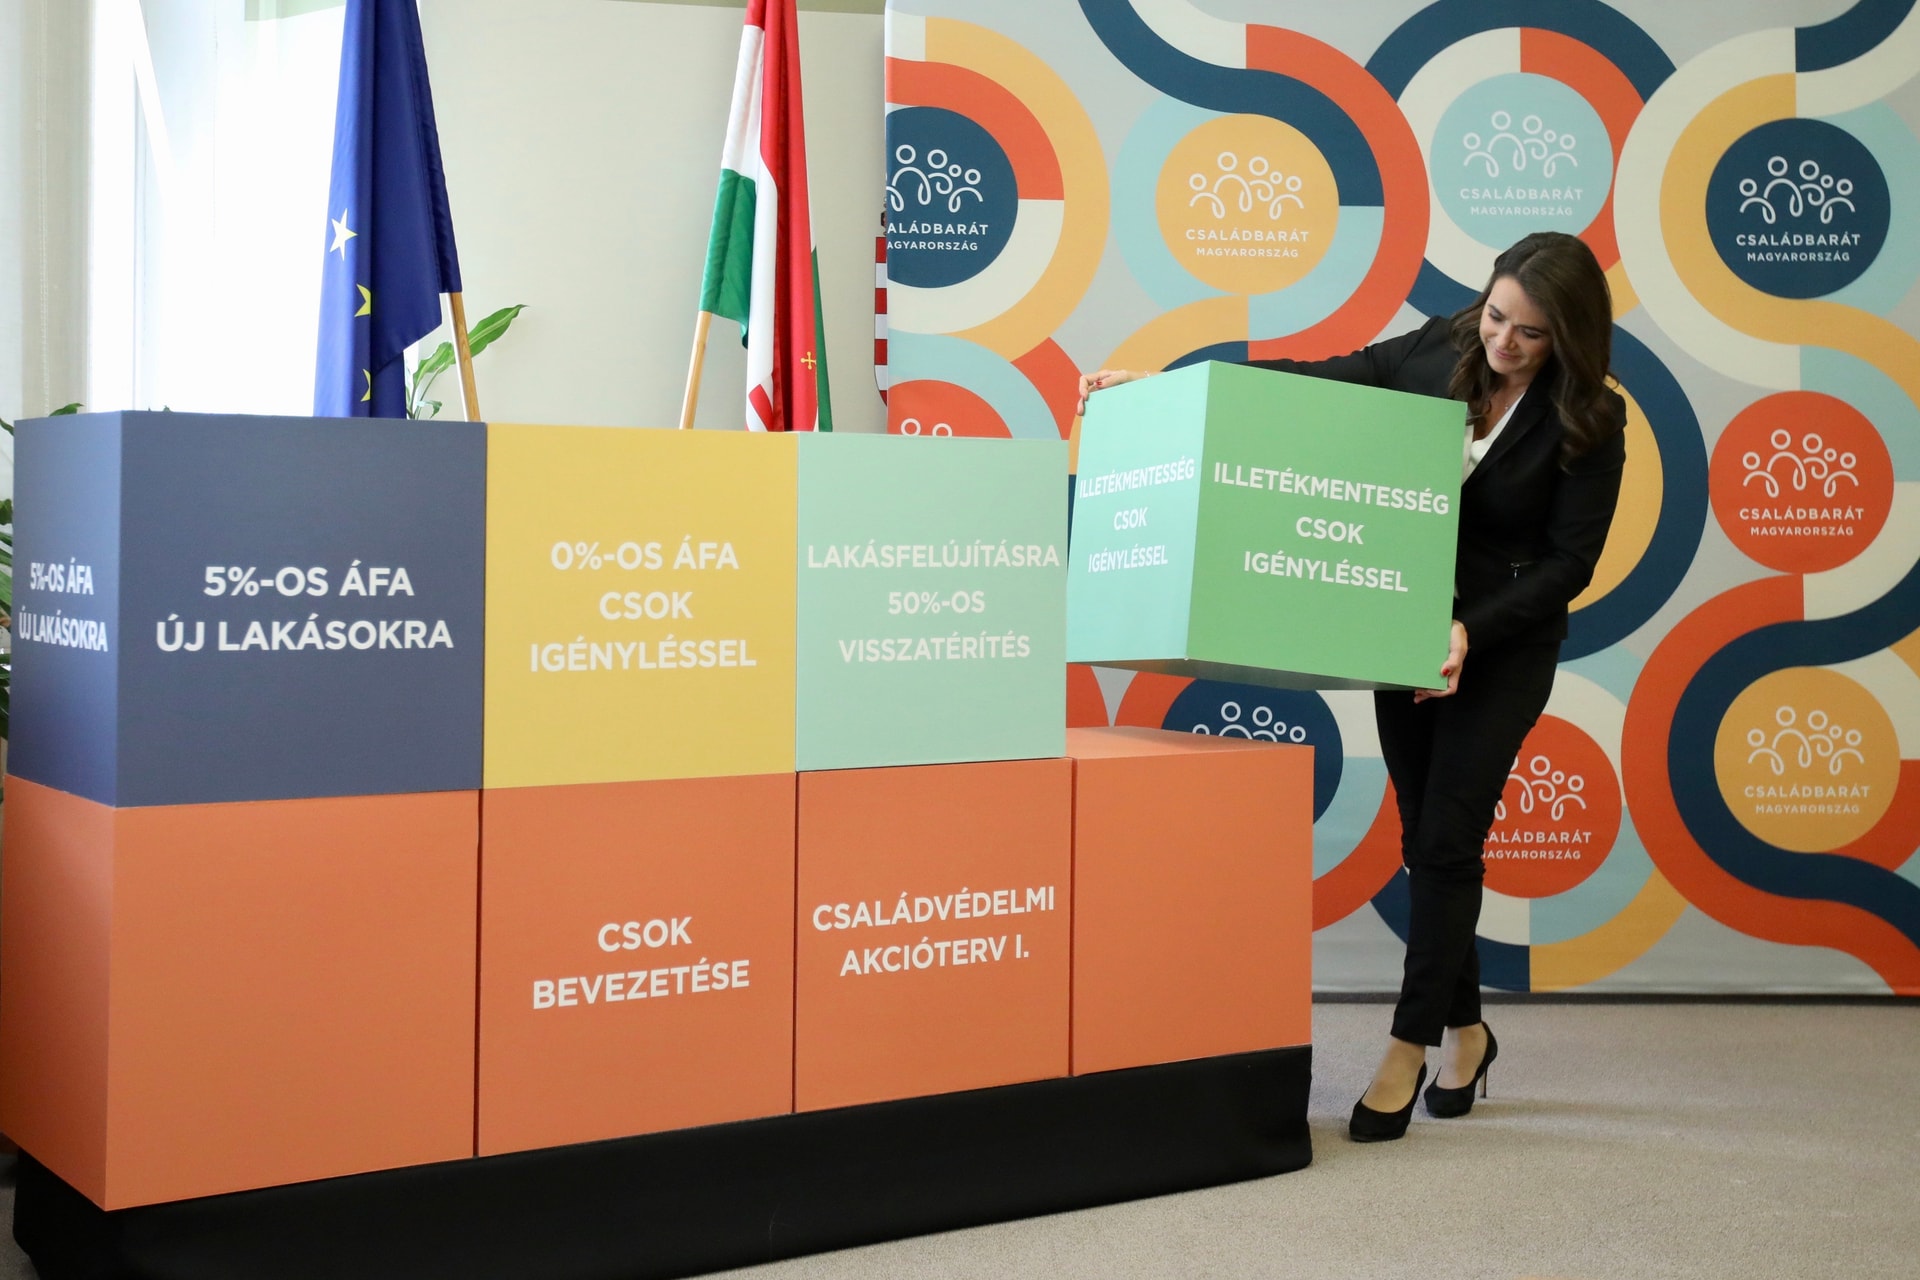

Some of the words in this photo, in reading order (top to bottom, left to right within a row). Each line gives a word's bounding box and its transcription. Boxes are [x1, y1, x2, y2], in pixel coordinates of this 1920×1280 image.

[1460, 186, 1582, 200] CSALÁDBARÁT
[1471, 205, 1572, 216] MAGYARORSZÁG
[887, 220, 988, 235] ALÁDBARÁT
[1186, 228, 1308, 241] CSALÁDBARÁT
[1736, 232, 1860, 246] CSALÁDBARÁT
[887, 239, 978, 251] AGYARORSZÁG
[1197, 247, 1298, 258] MAGYARORSZÁG
[1748, 250, 1849, 262] MAGYARORSZÁG
[1079, 455, 1195, 498] ILLETÉKMENTESSÉG
[1213, 462, 1449, 515] ILLETÉKMENTESSÉG
[1114, 507, 1147, 530] CSOK
[1739, 506, 1863, 520] CSALÁDBARÁT
[1296, 517, 1364, 544] CSOK
[1751, 525, 1853, 536] MAGYARORSZÁG
[551, 542, 663, 570] 0%-OS
[673, 535, 739, 569] ÁFA
[808, 539, 1059, 568] LAKÁSFELÚJÍTÁSRA
[1088, 544, 1168, 572] IGÉNYLÉSSEL
[31, 563, 64, 592] 5%-OS
[67, 558, 93, 595] ÁFA
[204, 567, 328, 596] 5%-OS
[340, 560, 414, 596] ÁFA
[1245, 550, 1408, 592] IGÉNYLÉSSEL
[600, 592, 692, 620] CSOK
[888, 591, 985, 614] 50%-OS
[19, 606, 31, 640] ÚJ
[34, 610, 108, 651] LAKÁSOKRA
[157, 614, 204, 651] ÚJ
[219, 613, 453, 650] LAKÁSOKRA
[531, 634, 756, 672] IGÉNYLÉSSEL
[839, 631, 1030, 662] VISSZATÉRÍTÉS
[1744, 784, 1869, 797] CSALÁDBARÁT
[1756, 803, 1859, 815] MAGYARORSZÁG
[1484, 828, 1592, 844] ALÁDBARÁT
[1482, 848, 1581, 860] AGYARORSZÁG
[812, 885, 1055, 932] CSALÁDVÉDELMI
[598, 917, 692, 952] CSOK
[839, 938, 1007, 977] AKCIÓTERV
[1016, 934, 1029, 958] I.
[534, 957, 749, 1009] BEVEZETÉSE
